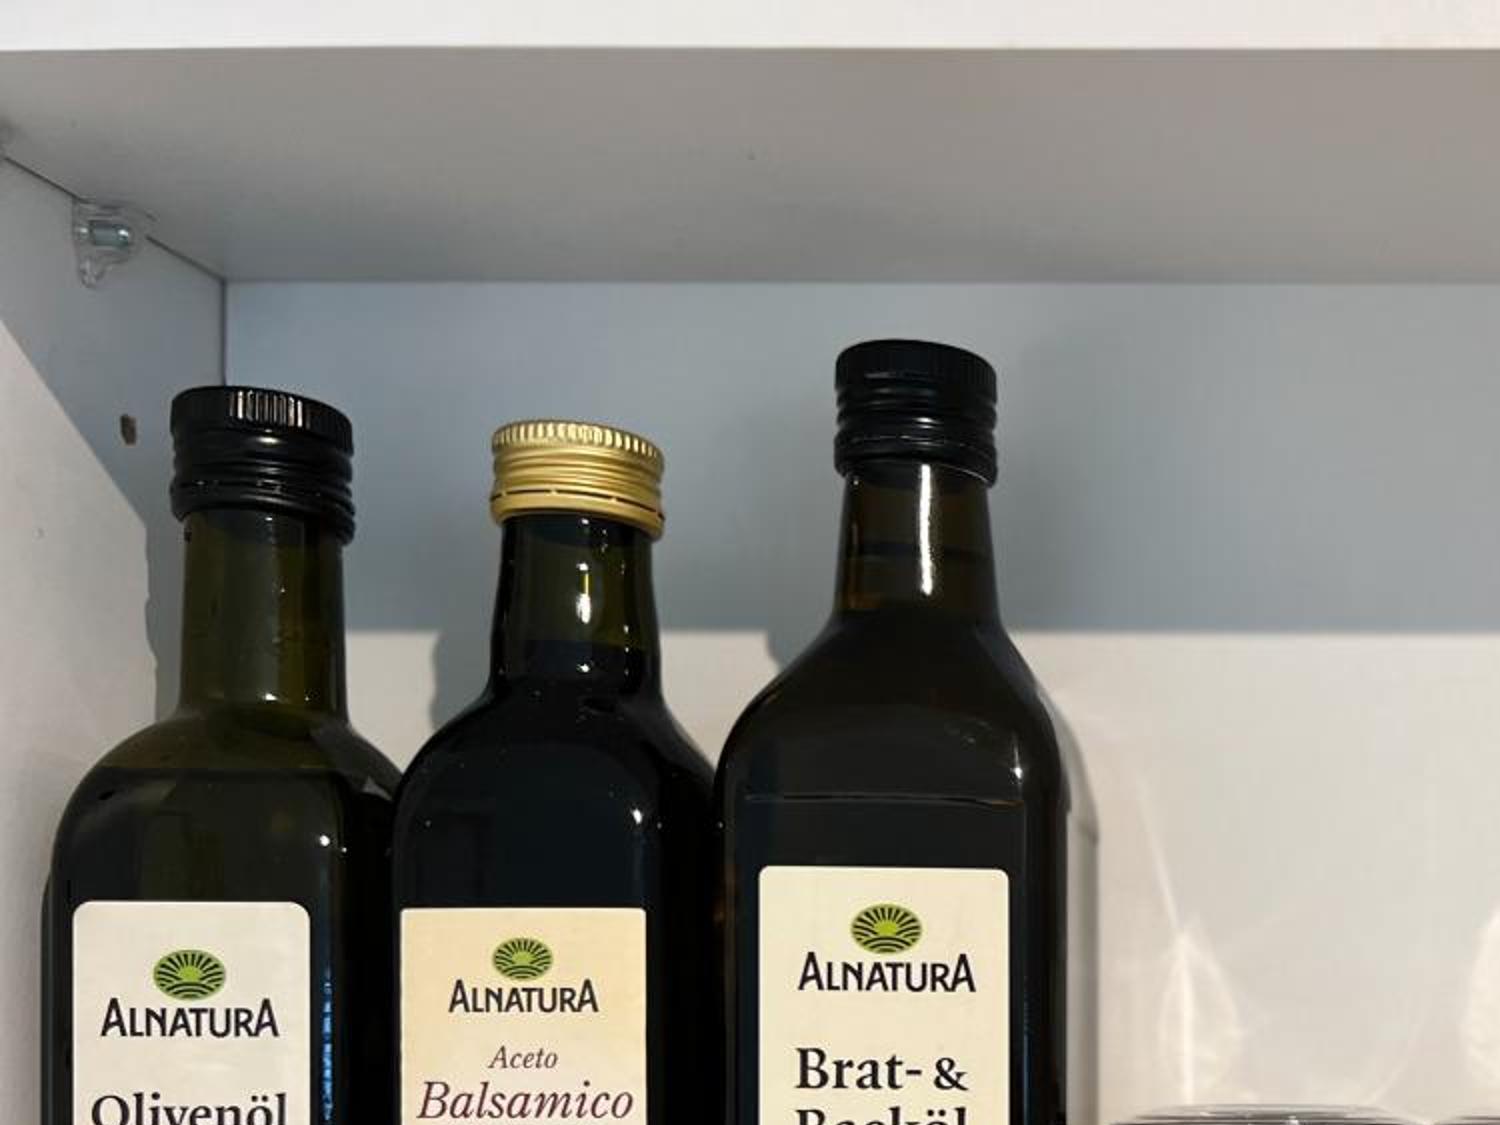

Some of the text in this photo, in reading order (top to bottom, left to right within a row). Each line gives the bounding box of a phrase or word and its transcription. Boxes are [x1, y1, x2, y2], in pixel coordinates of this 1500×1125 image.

[798, 951, 976, 992] ALNATURA
[448, 978, 599, 1014] ALNATURA
[101, 998, 279, 1037] ALNATURA
[488, 1045, 558, 1069] Aceto
[795, 1047, 969, 1091] Brat- &
[416, 1080, 634, 1119] Balsamico
